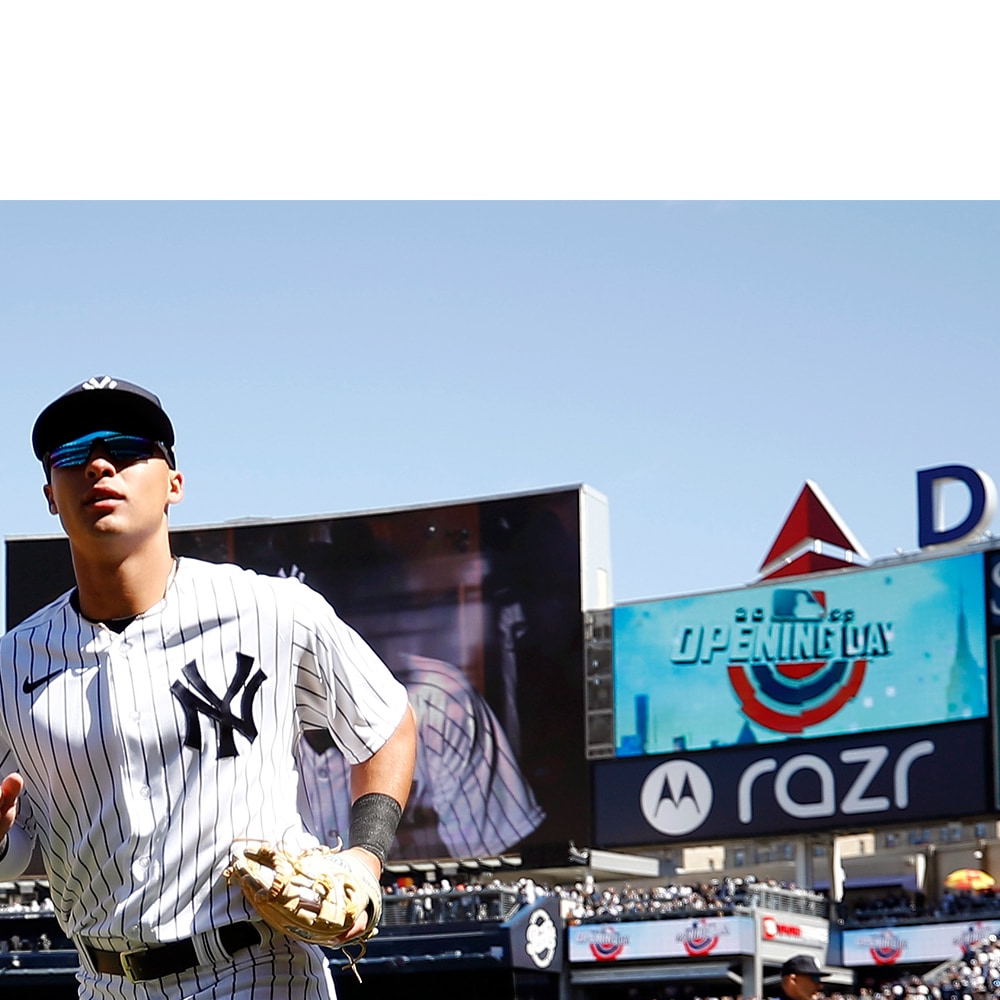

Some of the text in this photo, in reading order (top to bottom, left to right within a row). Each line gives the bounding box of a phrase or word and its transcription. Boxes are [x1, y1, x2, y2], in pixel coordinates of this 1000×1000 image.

[671, 622, 893, 665] OPENING DAY
[170, 652, 268, 758] NY
[738, 740, 935, 825] razr
